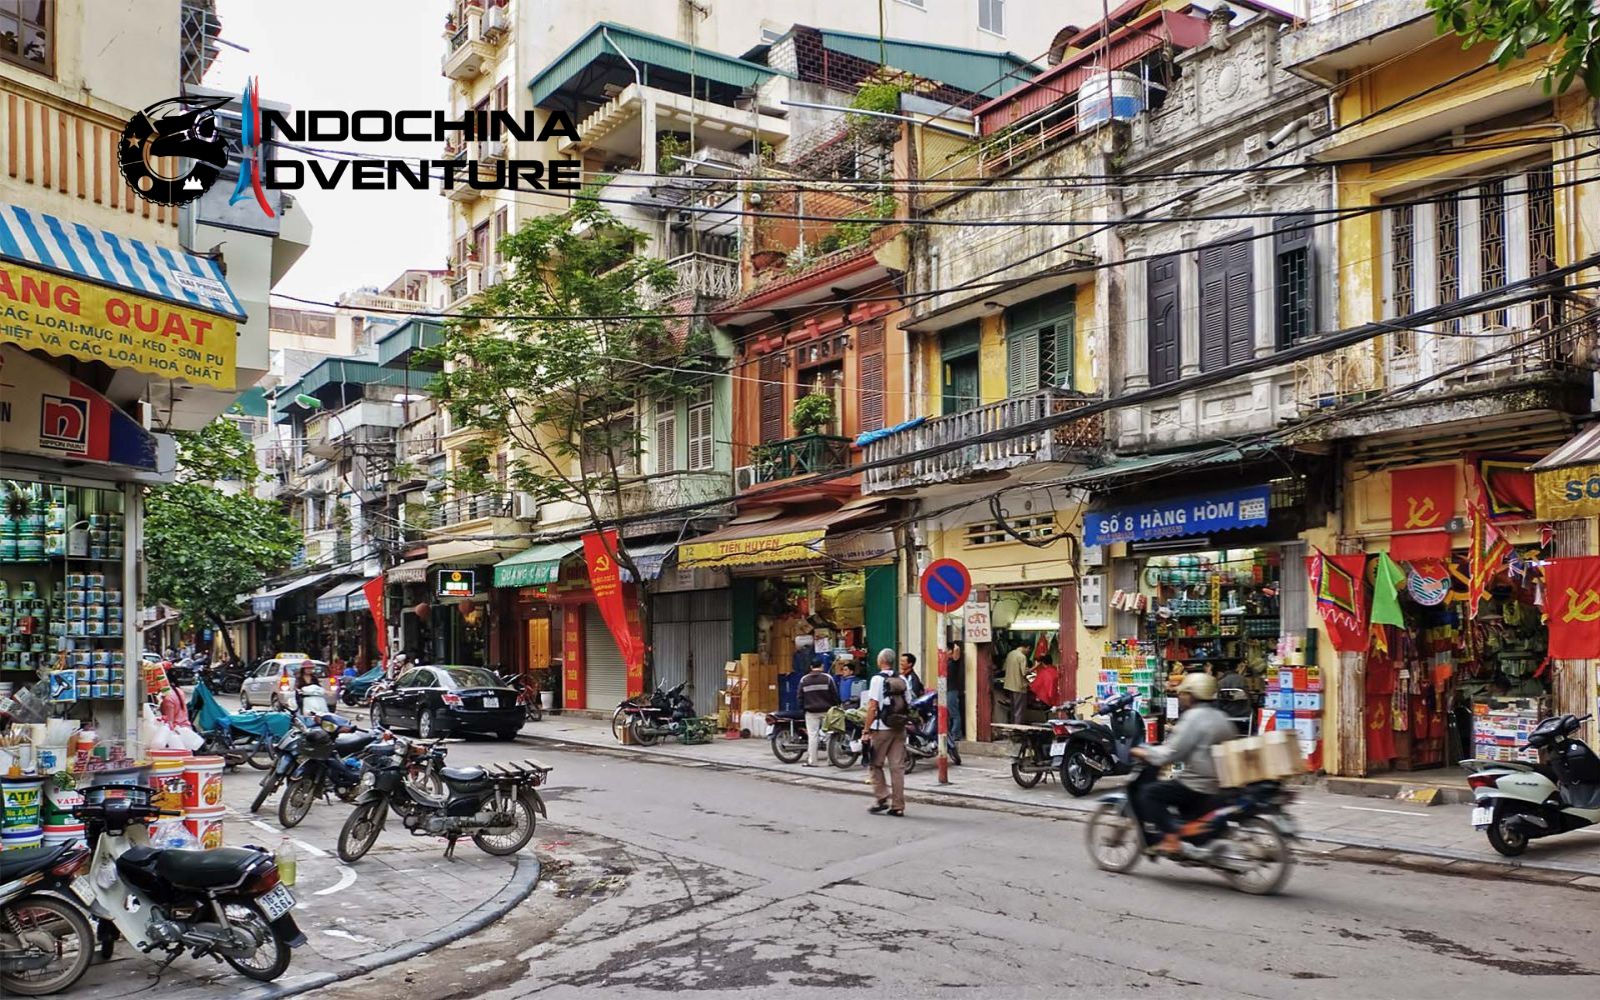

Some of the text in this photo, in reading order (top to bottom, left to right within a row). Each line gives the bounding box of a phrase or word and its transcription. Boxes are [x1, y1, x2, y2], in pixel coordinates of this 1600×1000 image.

[105, 298, 212, 345] QUẠT
[0, 305, 28, 322] ÁC
[120, 333, 132, 346] IN
[206, 353, 224, 366] PU
[40, 332, 61, 347] VÀ
[69, 340, 102, 355] CÁC
[109, 348, 143, 365] LOẠI
[184, 364, 221, 381] CHẤT
[1100, 512, 1122, 533] SỐ
[1125, 516, 1134, 531] 8
[1140, 509, 1186, 529] HÀNG
[1194, 501, 1234, 522] HÒM
[1451, 520, 1457, 531] 6
[685, 548, 694, 556] 12
[968, 625, 988, 637] TÓC
[7, 790, 39, 802] ATM
